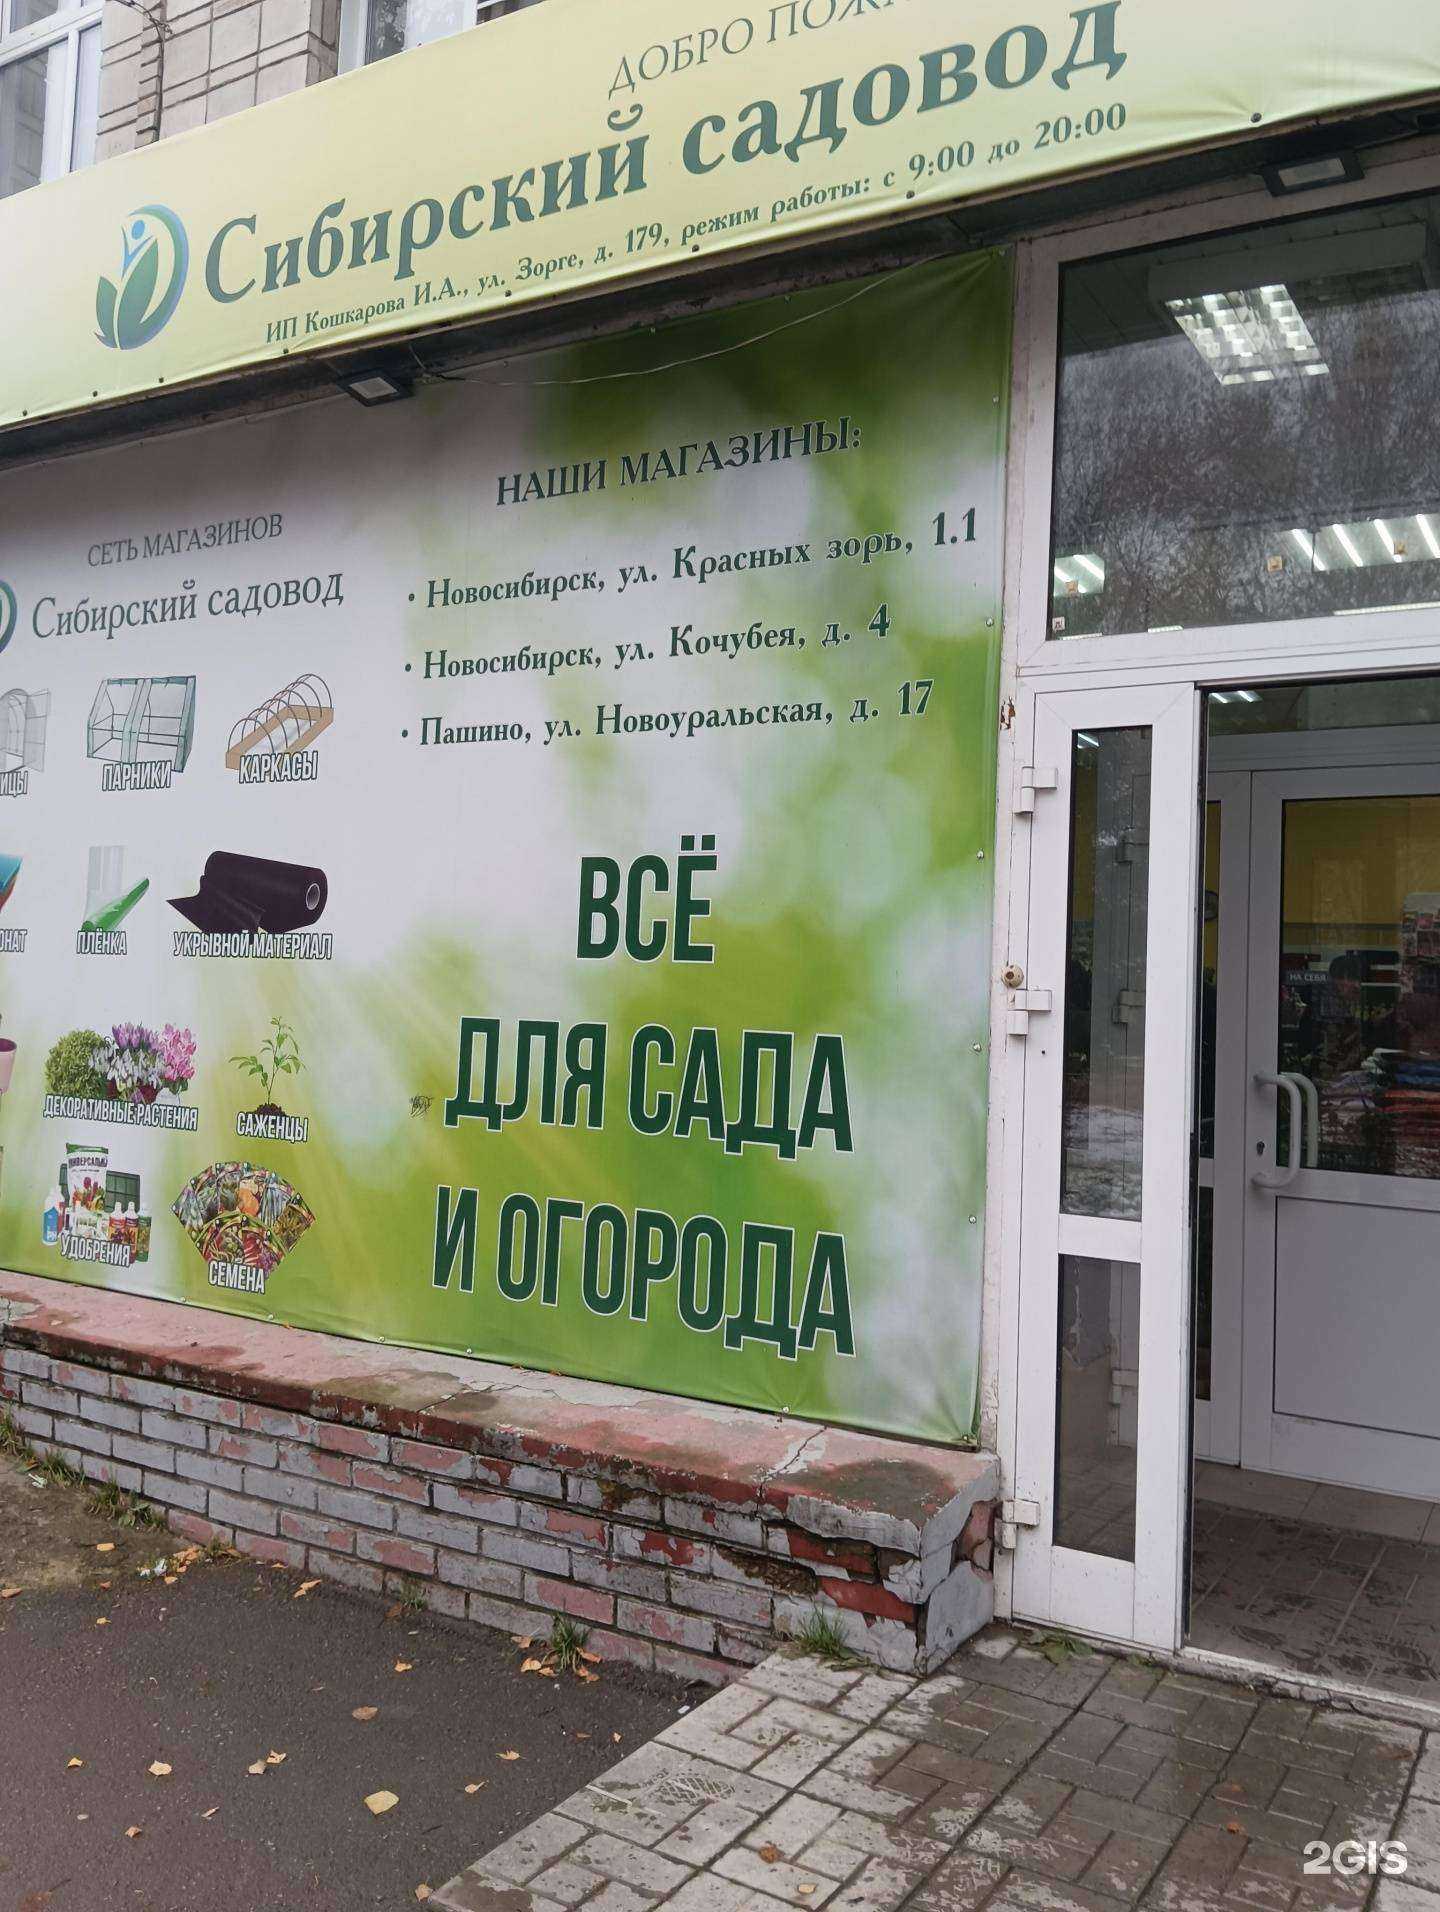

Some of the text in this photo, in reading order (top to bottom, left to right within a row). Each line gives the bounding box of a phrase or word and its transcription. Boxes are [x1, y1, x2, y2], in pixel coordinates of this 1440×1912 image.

[608, 17, 754, 100] ДОБРО
[205, 1, 1128, 303] Сибирский садовод
[266, 102, 1127, 344] ИП Кошкарова И.А., ул. Зорге, д. 179, режим работы: с 9:00 до 20:00
[495, 416, 862, 507] НАШИ МАГАЗИНЫ:
[87, 513, 284, 568] СЕТЬ МАГАЗИНОВ
[426, 507, 978, 609] Новосибирск, ул. Красных зорь, 1.1
[32, 572, 345, 640] Сибирский садовод
[423, 602, 891, 680] Новосибирск, ул. Кочубея, д. 4
[419, 679, 935, 746] Пашино, ул. Новоуральская, д. 17
[102, 760, 173, 791] ПАРНИКИ
[238, 751, 319, 784] КАРКАСЫ
[576, 833, 719, 963] ВСЁ
[76, 927, 128, 955] ПЛЁНКА
[173, 929, 334, 960] УКРЫВНОЙ МАТЕРИАЛ
[43, 1094, 199, 1131] ДЕКОРАТИВНЫЕ РАСТЕНИЯ
[443, 1015, 855, 1162] ДЛЯ САДА
[236, 1111, 309, 1143] САЖЕНЦЫ
[61, 1233, 131, 1267] УДОБРЕНИЯ
[208, 1259, 266, 1294] СЕМЕНА
[431, 1184, 857, 1362] И ОГОРОДА
